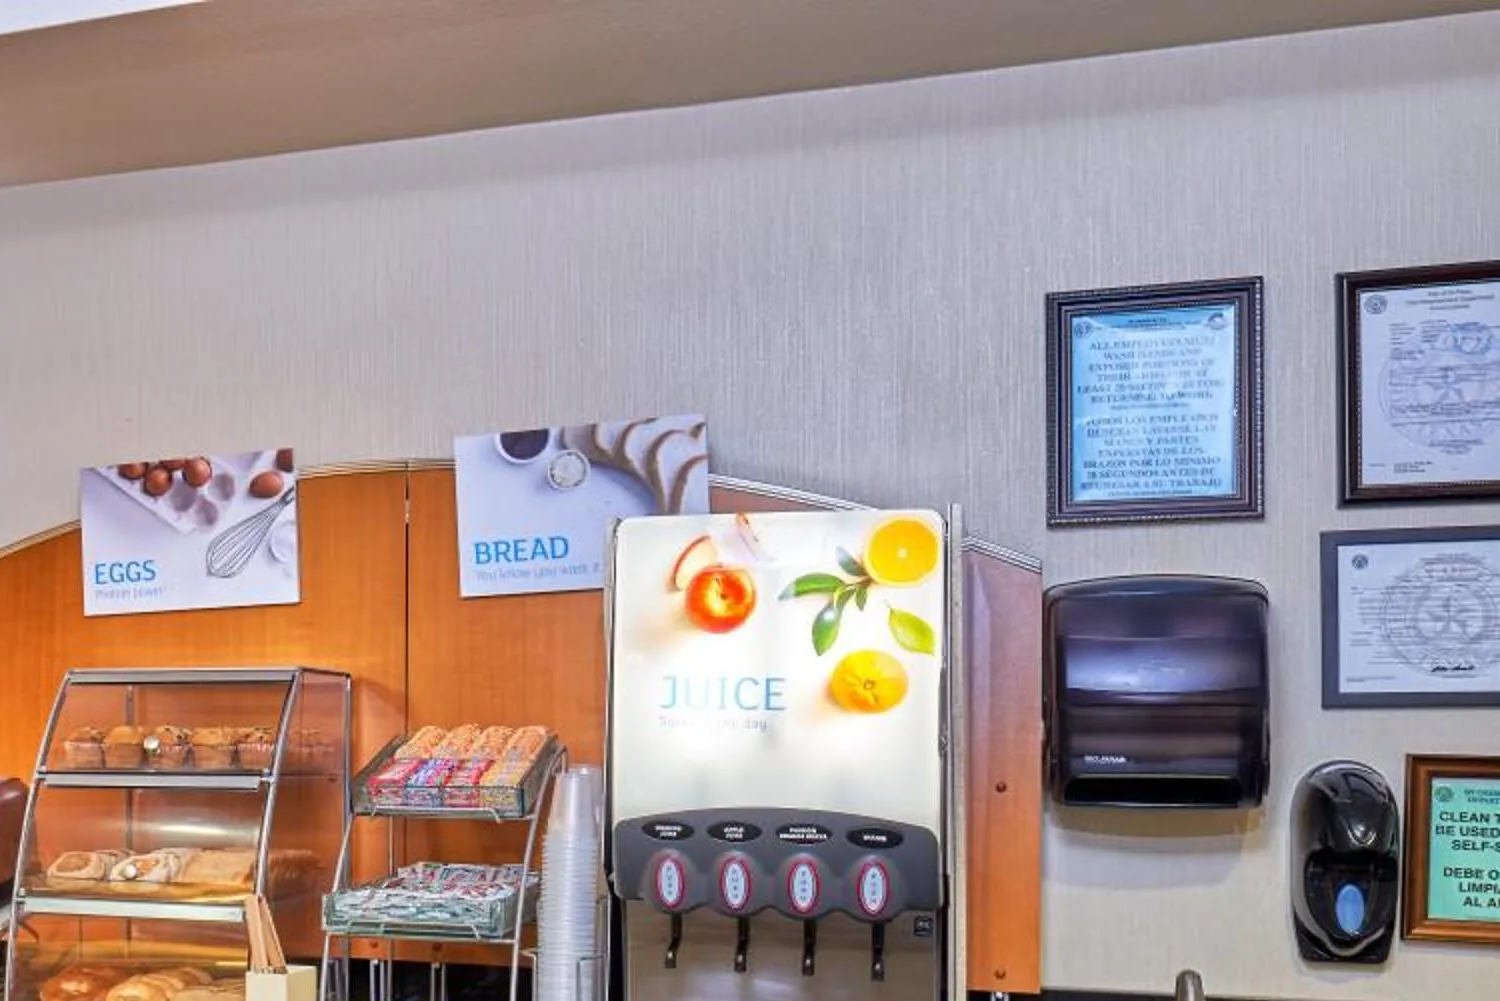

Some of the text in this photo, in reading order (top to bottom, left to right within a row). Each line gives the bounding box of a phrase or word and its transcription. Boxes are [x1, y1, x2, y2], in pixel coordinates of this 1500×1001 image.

[473, 535, 570, 565] BREAD
[95, 559, 157, 585] EGGS
[659, 675, 788, 711] JUICE
[1439, 811, 1490, 824] CLEAN
[1435, 825, 1500, 839] BE USED
[1443, 867, 1484, 879] DEBE
[1459, 882, 1500, 894] LIMPI
[1463, 896, 1481, 908] AL
